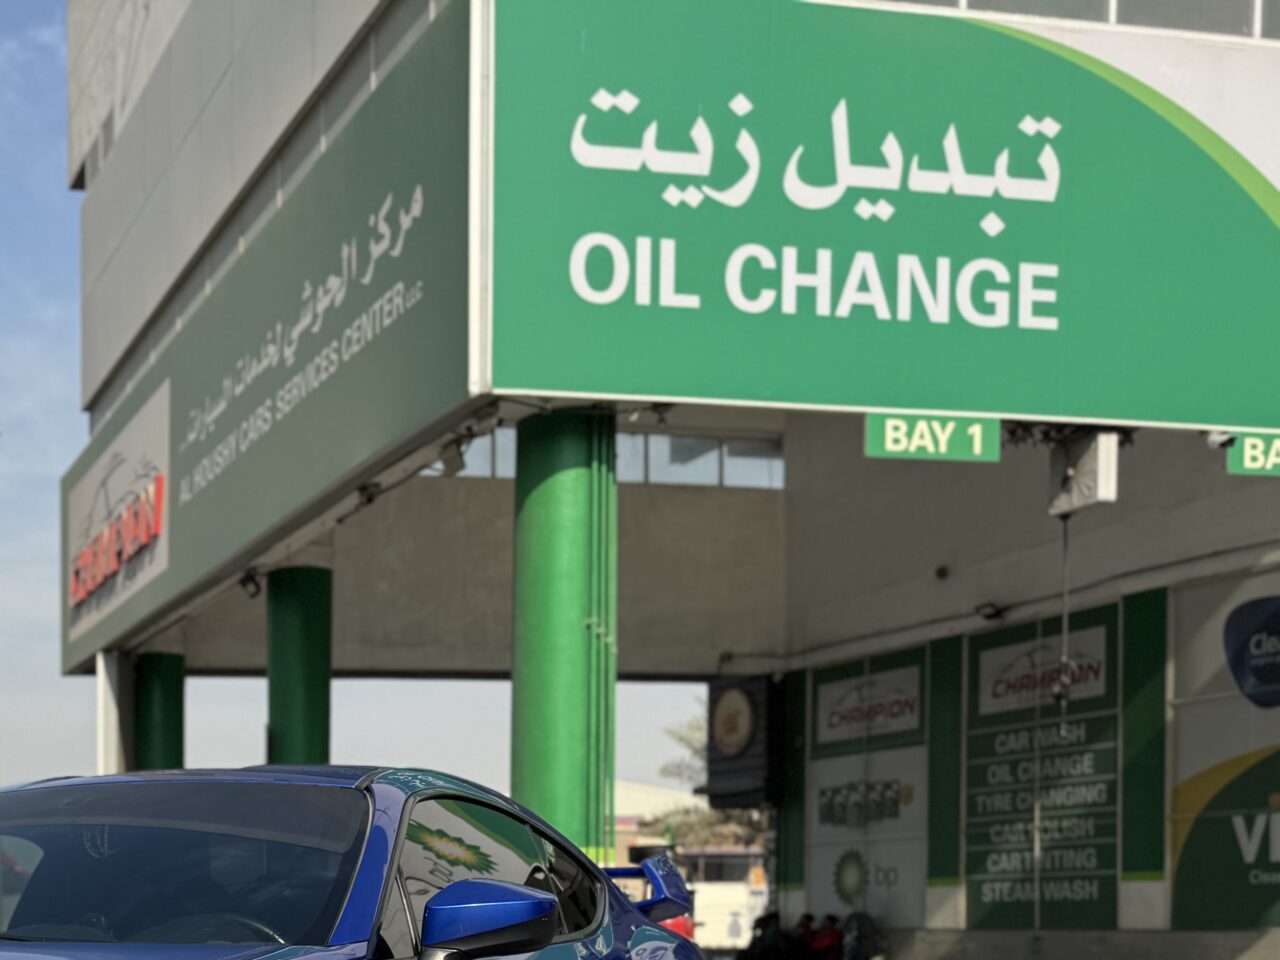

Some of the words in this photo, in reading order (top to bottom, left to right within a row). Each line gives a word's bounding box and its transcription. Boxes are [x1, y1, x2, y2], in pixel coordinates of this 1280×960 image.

[570, 87, 761, 209] زيت
[783, 98, 1062, 238] تبديل
[360, 184, 423, 285] مركز
[568, 231, 701, 309] OIL
[724, 243, 1059, 331] CHANGE
[274, 340, 339, 420] SERVICES
[341, 280, 405, 362] CENTER
[883, 418, 956, 455] BAY
[966, 423, 983, 456] 1
[994, 731, 1030, 754] CAR
[986, 763, 1015, 785] OIL
[975, 792, 1013, 814] TYRE
[986, 852, 1022, 873] CAR
[1042, 879, 1099, 903] WASH
